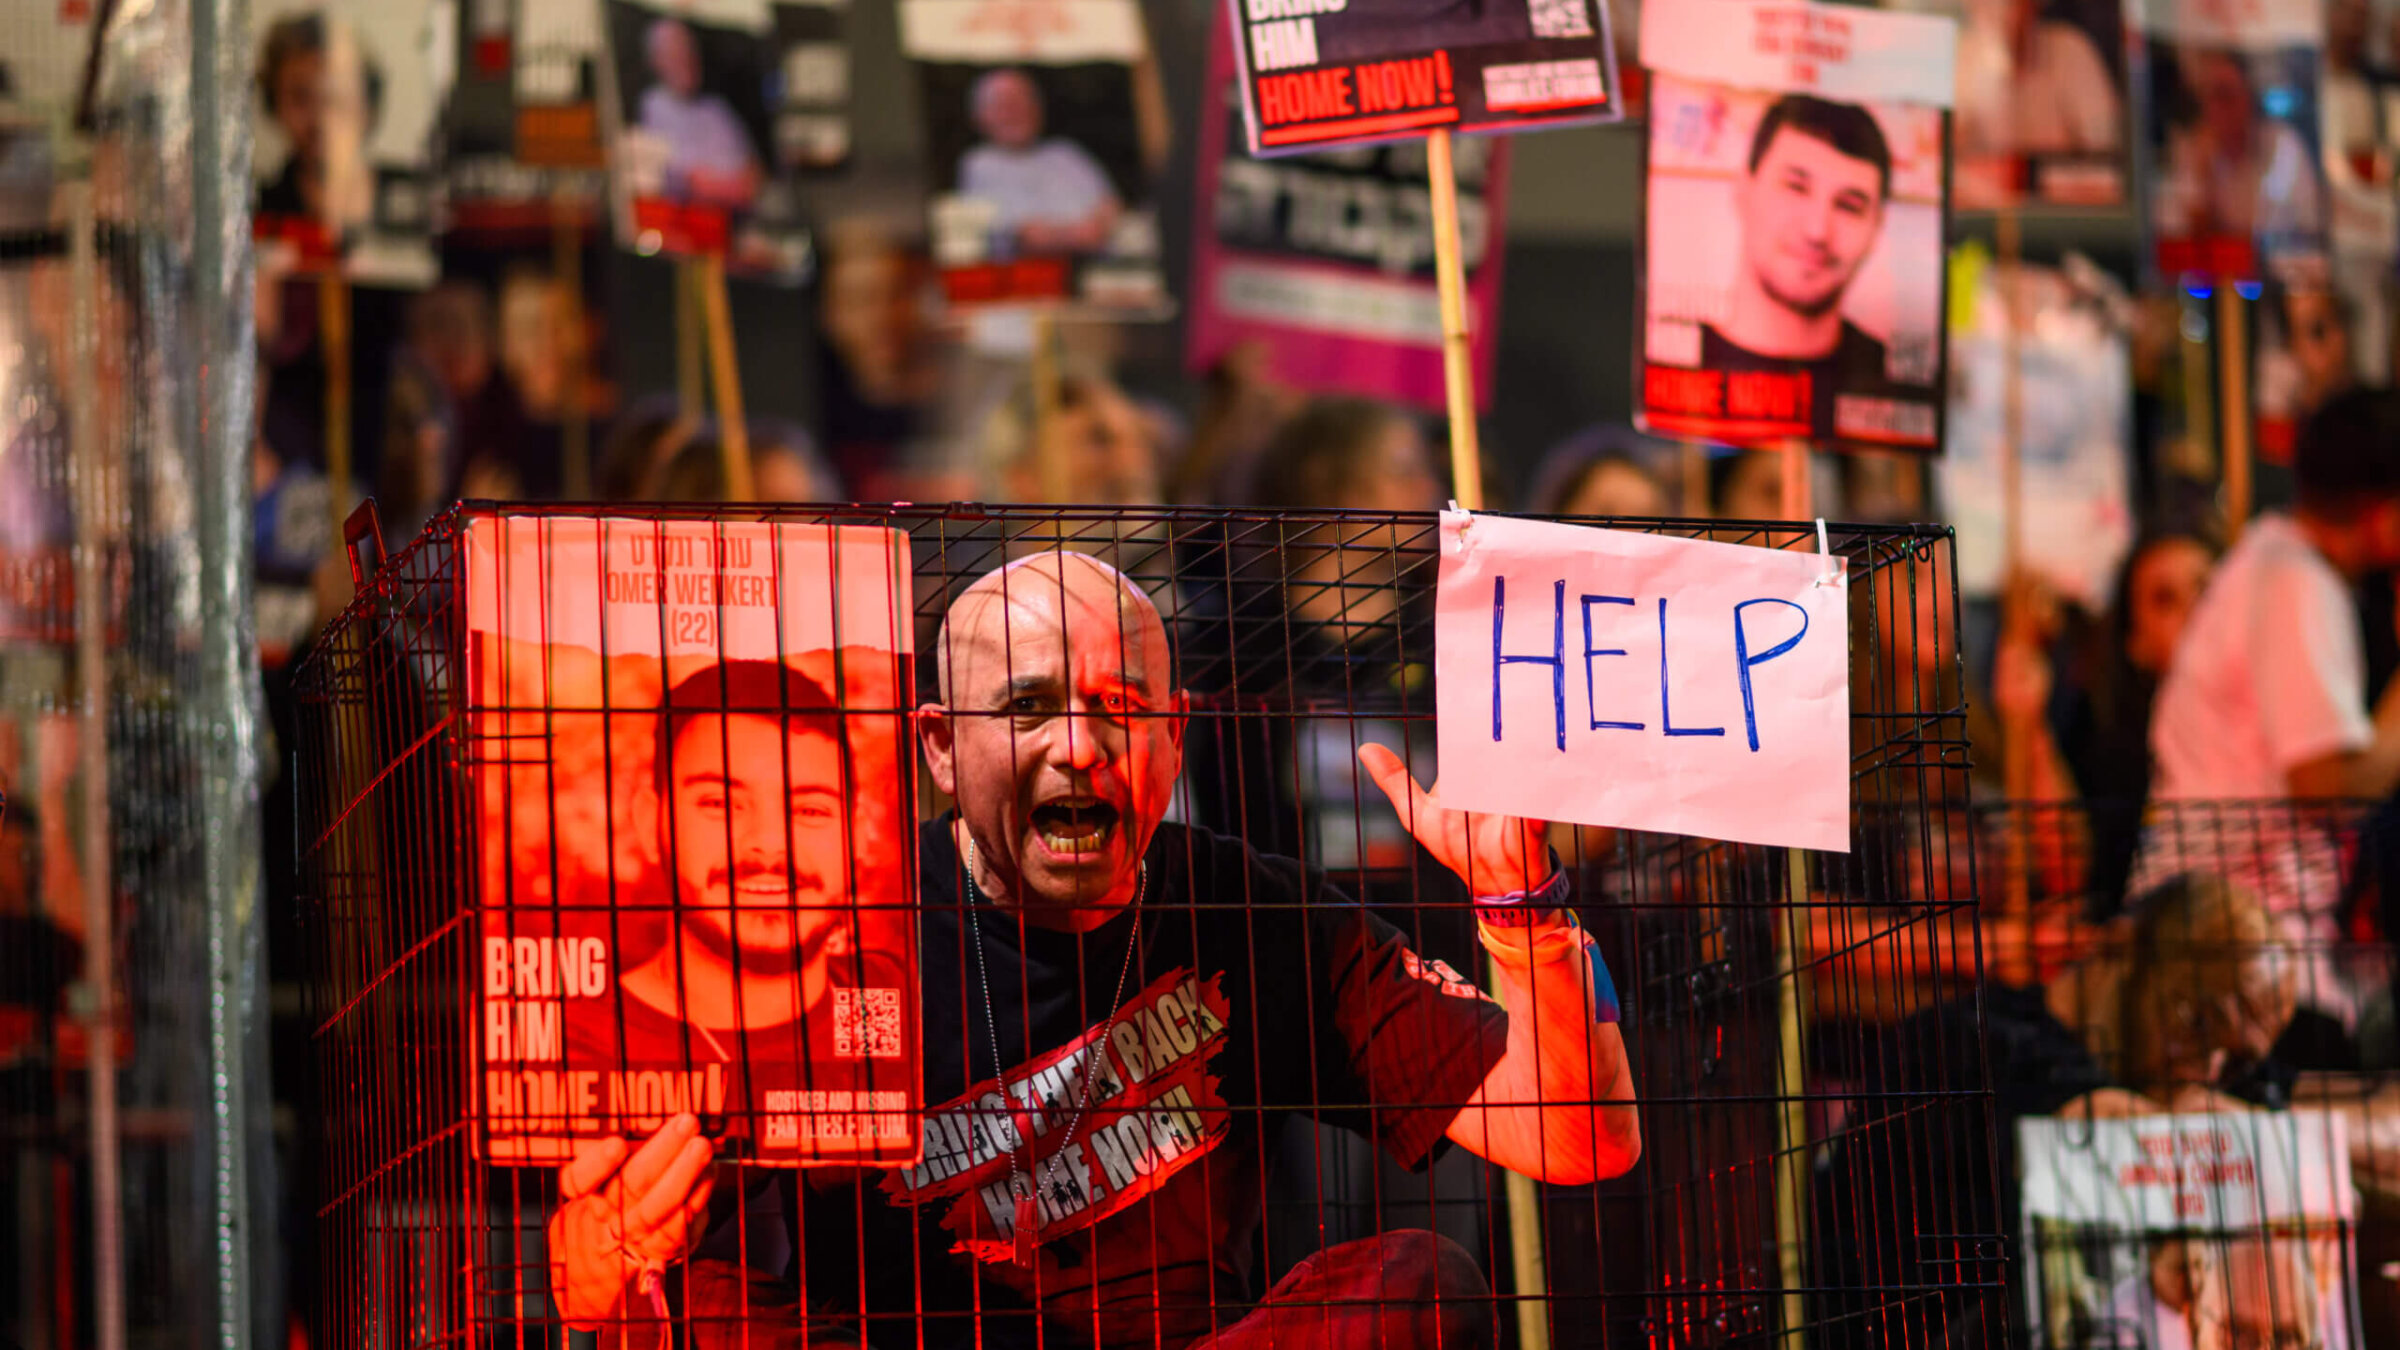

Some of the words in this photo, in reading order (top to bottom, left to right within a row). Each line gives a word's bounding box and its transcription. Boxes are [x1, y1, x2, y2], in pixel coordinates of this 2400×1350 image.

[1251, 17, 1319, 71] HIM
[1258, 67, 1355, 126] HOME
[1355, 49, 1455, 113] NOW!
[607, 572, 668, 605] OMER
[671, 609, 716, 648] (22)
[1493, 576, 1808, 751] HELP
[486, 937, 606, 998] BRING
[486, 1001, 563, 1062] HIM
[1009, 1037, 1124, 1139] THEM
[1111, 977, 1224, 1084] BACK
[486, 1070, 600, 1133] HOME
[609, 1062, 728, 1133] NOW!
[766, 1090, 827, 1112] HOSTAGES
[829, 1091, 853, 1112] AND
[856, 1091, 907, 1112] MISSING
[766, 1114, 843, 1139] FAMILIES
[846, 1114, 908, 1139] FORUM
[1090, 1083, 1205, 1191] NOW!
